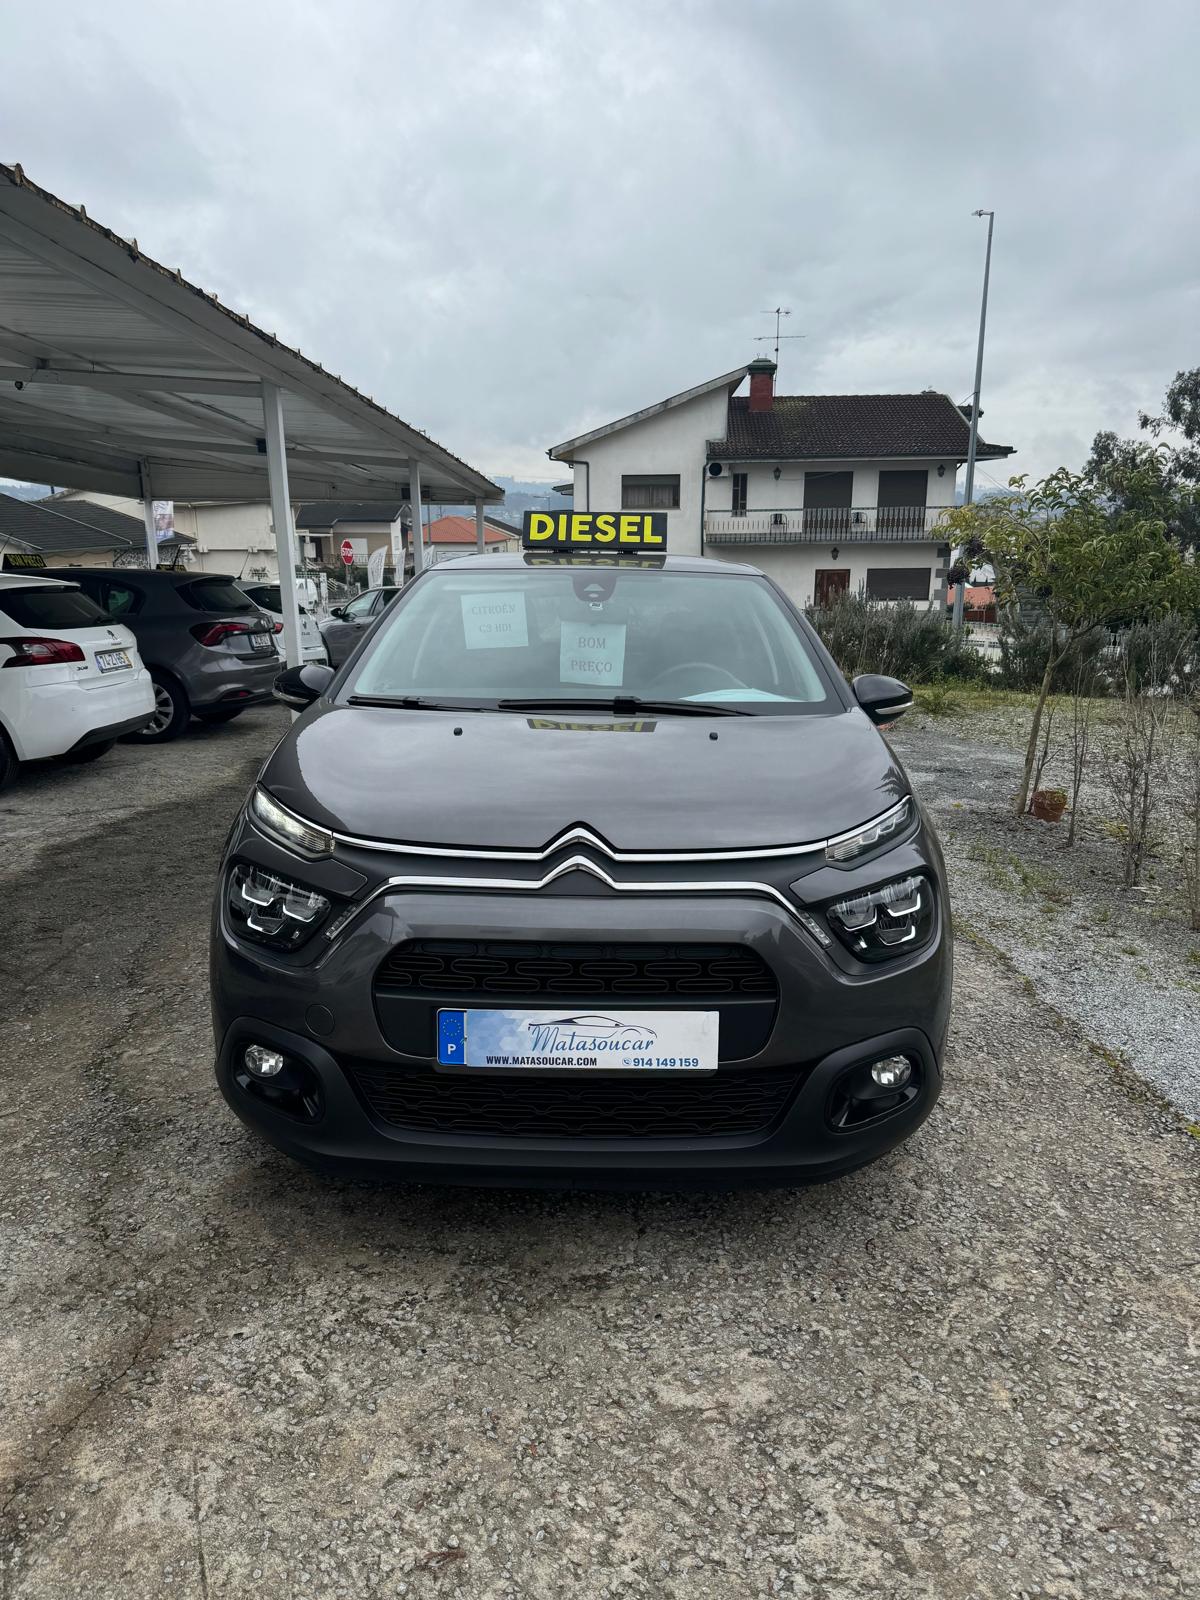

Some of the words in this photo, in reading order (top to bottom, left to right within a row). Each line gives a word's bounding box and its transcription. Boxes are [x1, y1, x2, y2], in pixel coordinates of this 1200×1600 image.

[529, 513, 663, 543] DIESEL
[577, 637, 606, 649] BOM
[570, 660, 613, 675] PREÇO
[531, 1024, 654, 1054] Matasoucar
[447, 1043, 457, 1055] P
[485, 1055, 598, 1067] WWW.MATASOUCAR.COM
[632, 1057, 653, 1067] 914
[655, 1058, 677, 1067] 149
[678, 1058, 700, 1067] 159
